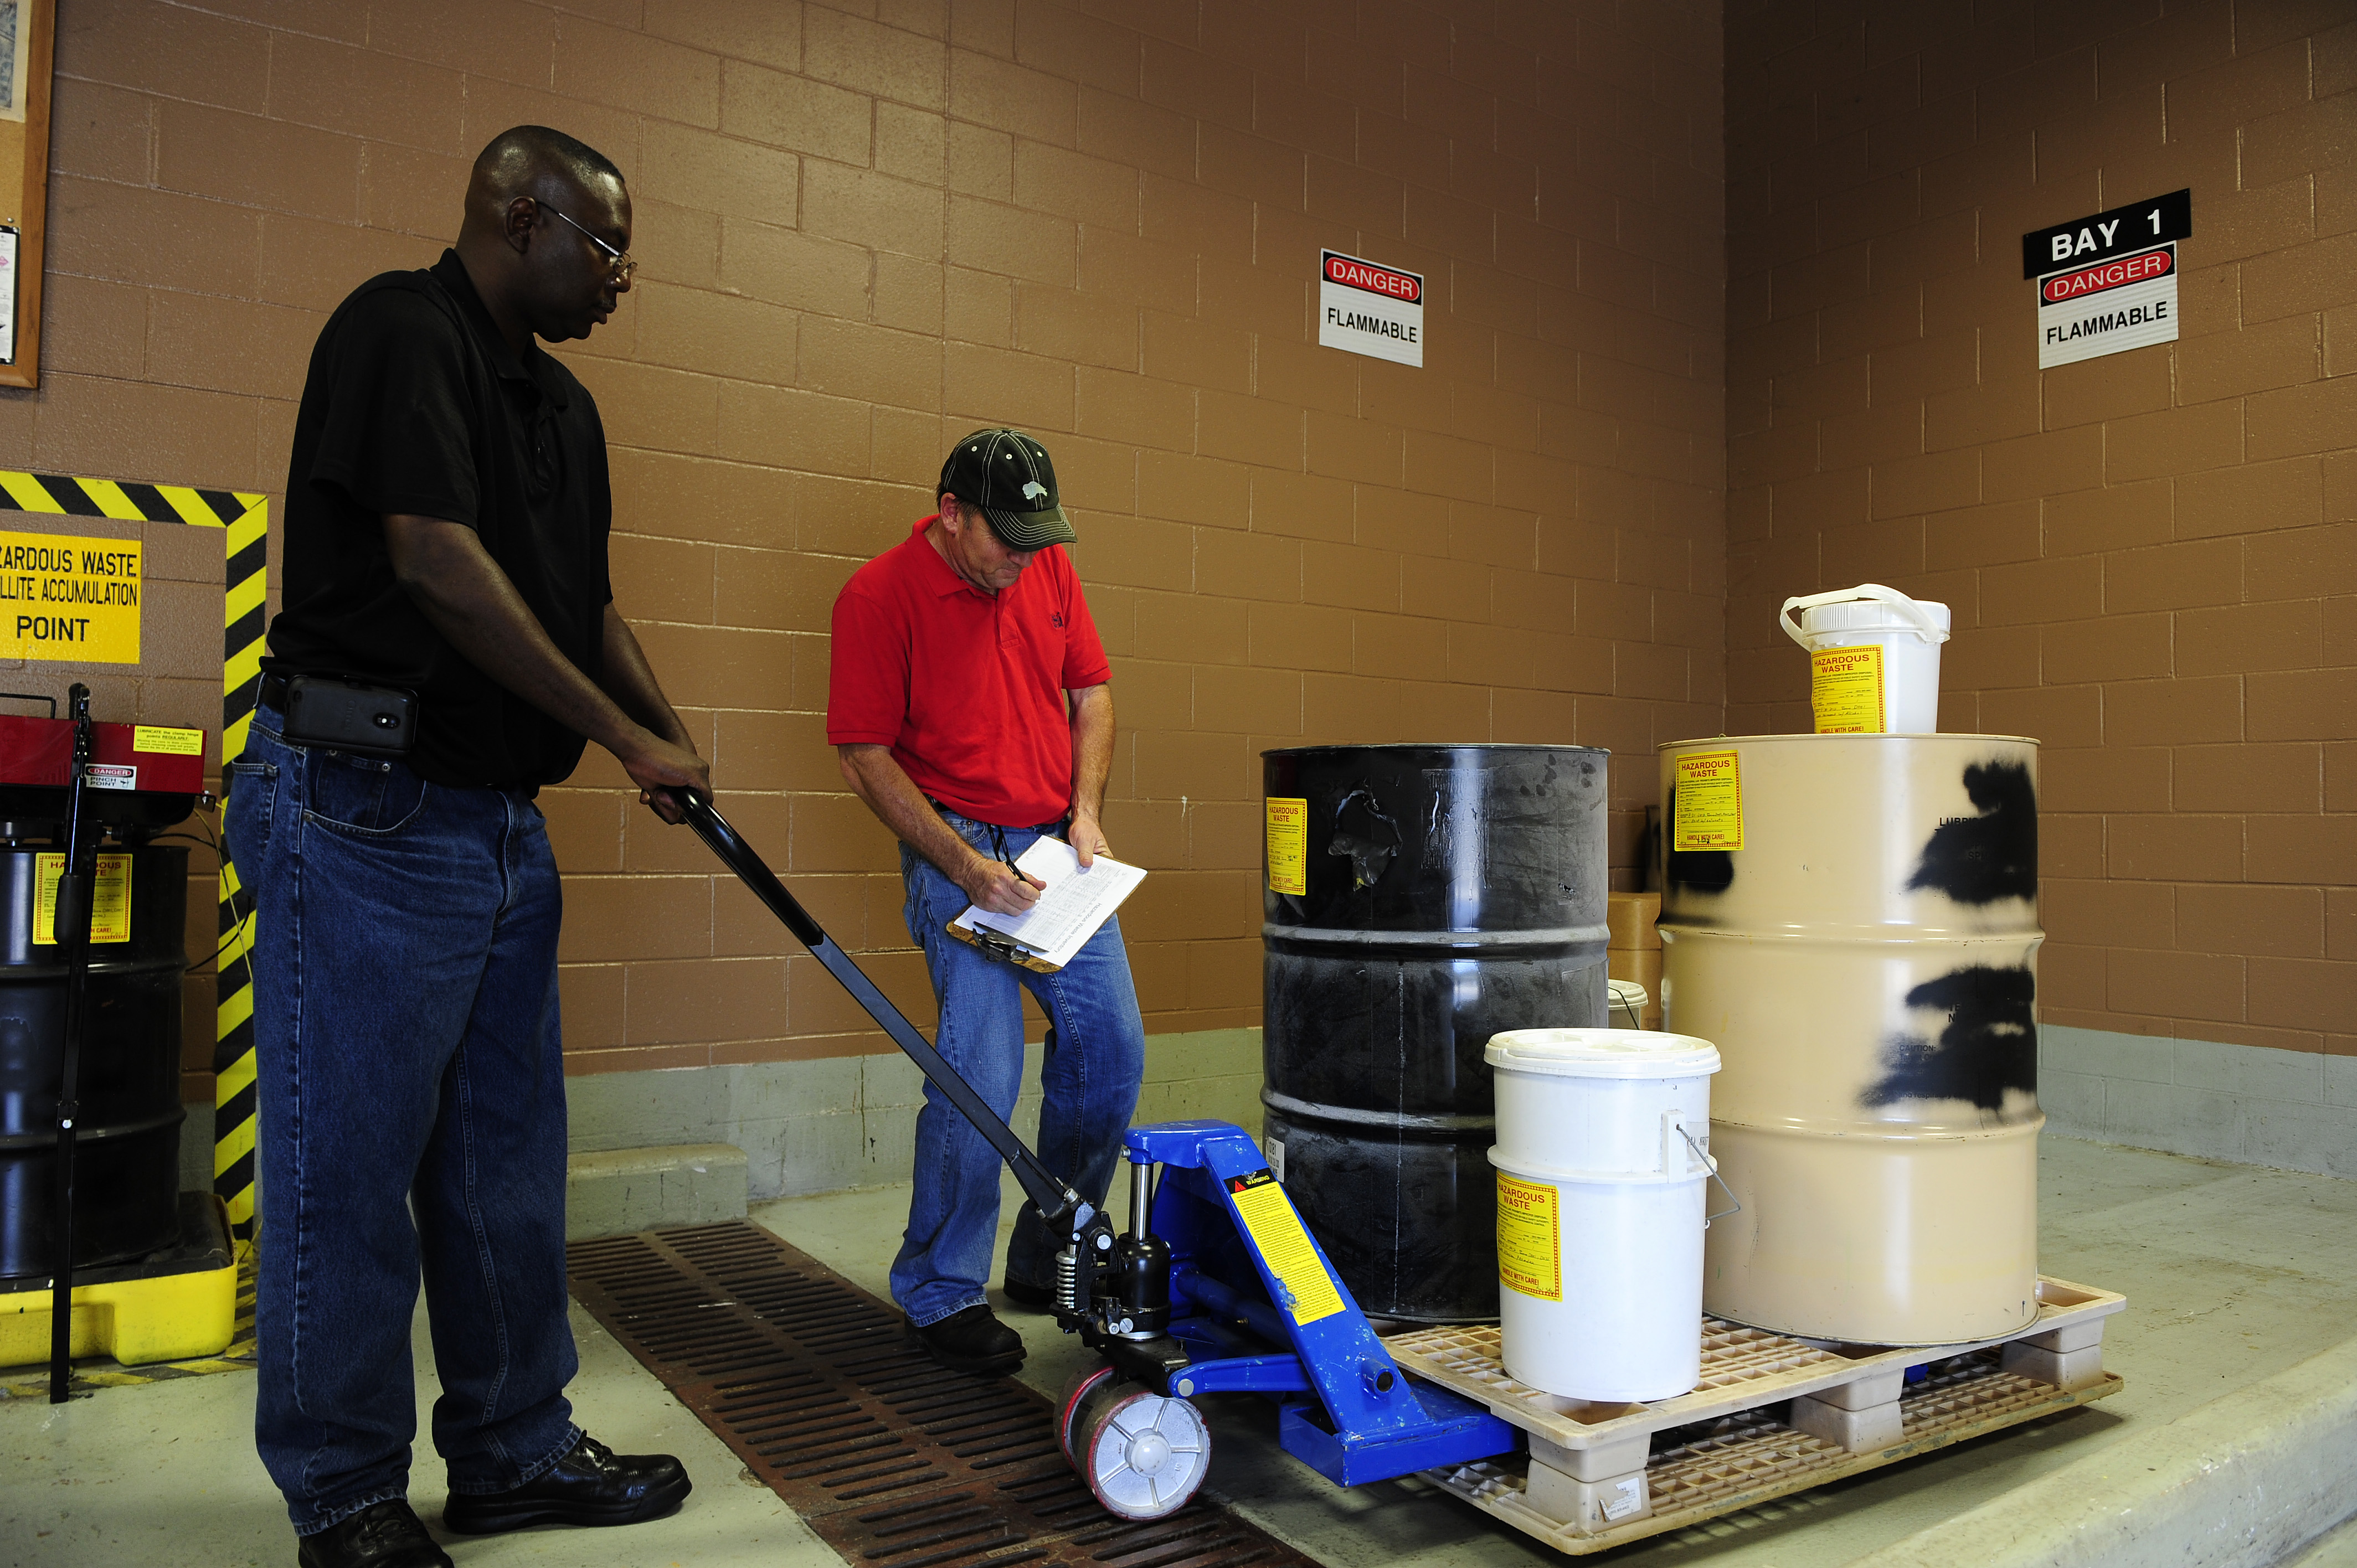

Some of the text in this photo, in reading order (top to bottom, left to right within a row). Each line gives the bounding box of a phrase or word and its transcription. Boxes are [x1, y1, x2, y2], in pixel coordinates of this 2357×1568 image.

[2052, 209, 2160, 261] BAY 1
[1332, 261, 1413, 297] DANGER
[2054, 255, 2162, 297] DANGER
[1327, 307, 1417, 343] FLAMMABLE
[2047, 301, 2168, 345] FLAMMABLE
[0, 544, 137, 577] ARDOUS WASTE
[41, 578, 137, 606] ACCUMULATION
[16, 615, 90, 641] POINT
[1814, 654, 1870, 667] HAZARDOUS
[1821, 663, 1854, 673] WASTE
[1681, 760, 1730, 771] HAZARDOUS
[1690, 769, 1717, 778] WASTE
[1269, 806, 1299, 815] HAZARDOUS
[1054, 902, 1102, 953] Hazardous Waste Inventory
[1498, 1182, 1545, 1203] HAZARDOUS
[1503, 1194, 1531, 1211] WASTE
[1525, 1276, 1539, 1286] CARE!
